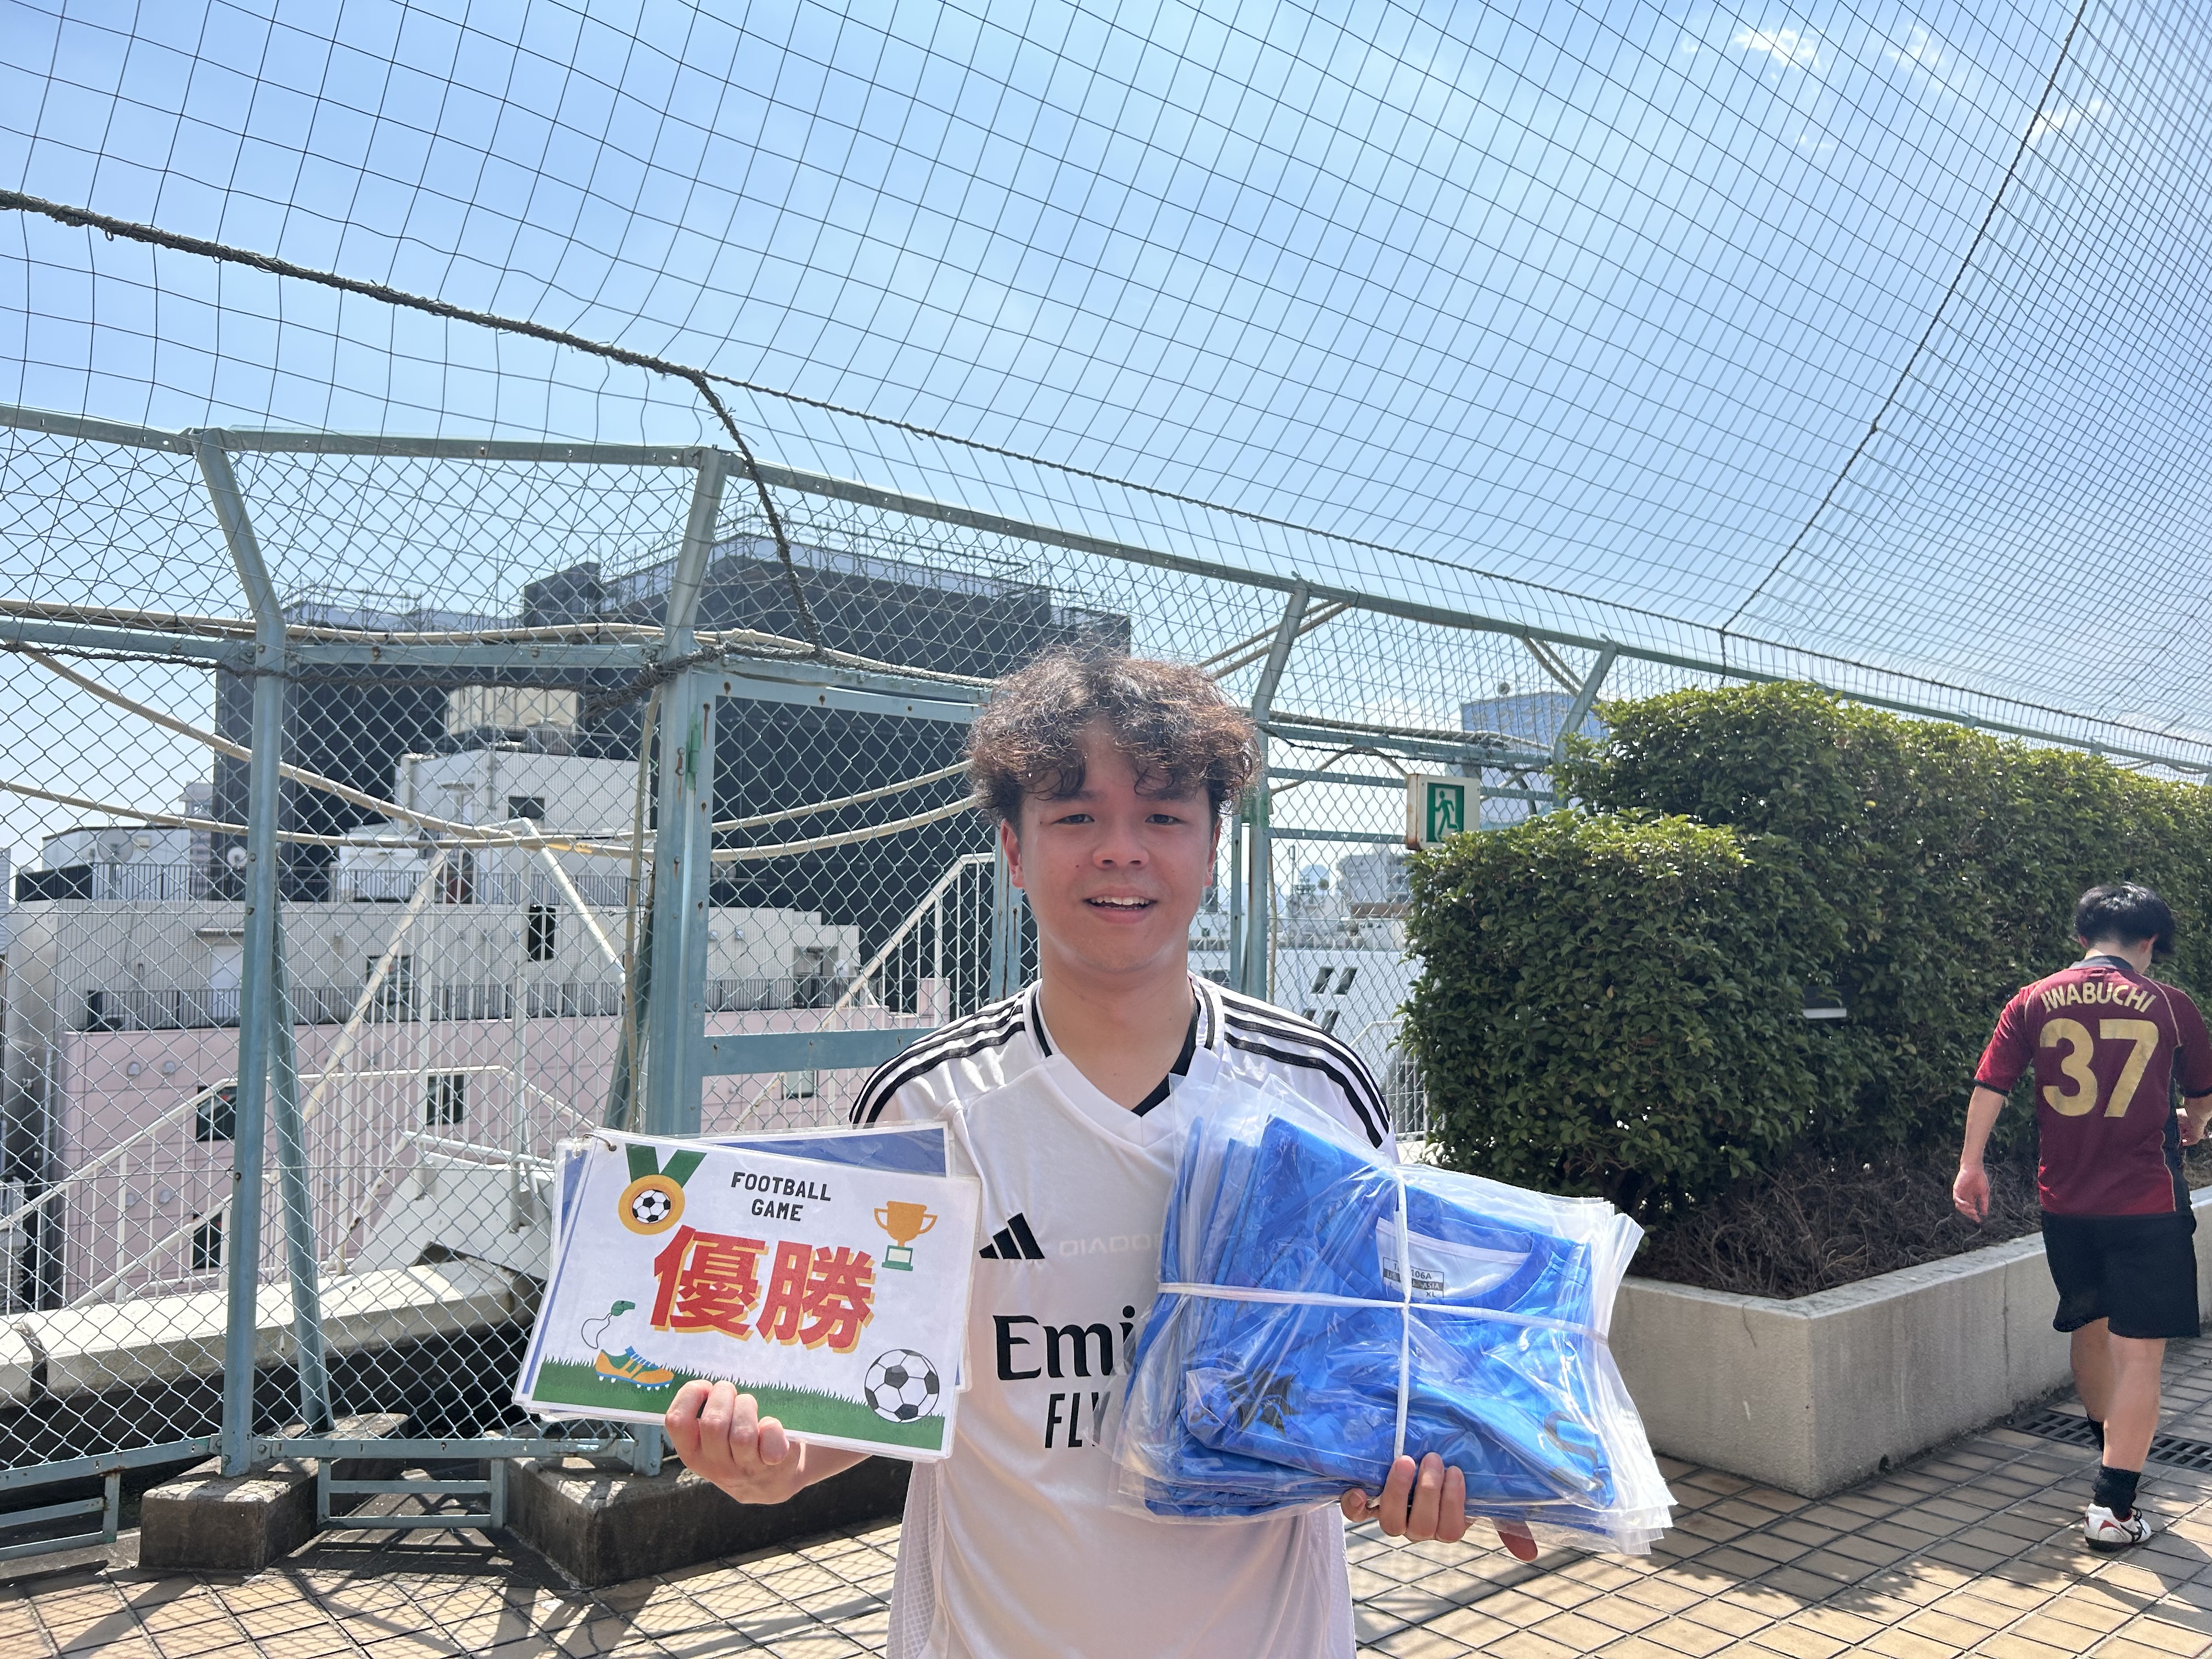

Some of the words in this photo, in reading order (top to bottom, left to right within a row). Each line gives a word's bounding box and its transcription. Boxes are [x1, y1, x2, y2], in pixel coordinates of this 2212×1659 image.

[2040, 981, 2156, 1013] IWABUCHI
[2040, 1018, 2159, 1118] 37
[731, 1171, 831, 1201] FOOTBALL
[752, 1199, 804, 1222] GAME
[651, 1224, 877, 1354] 優勝
